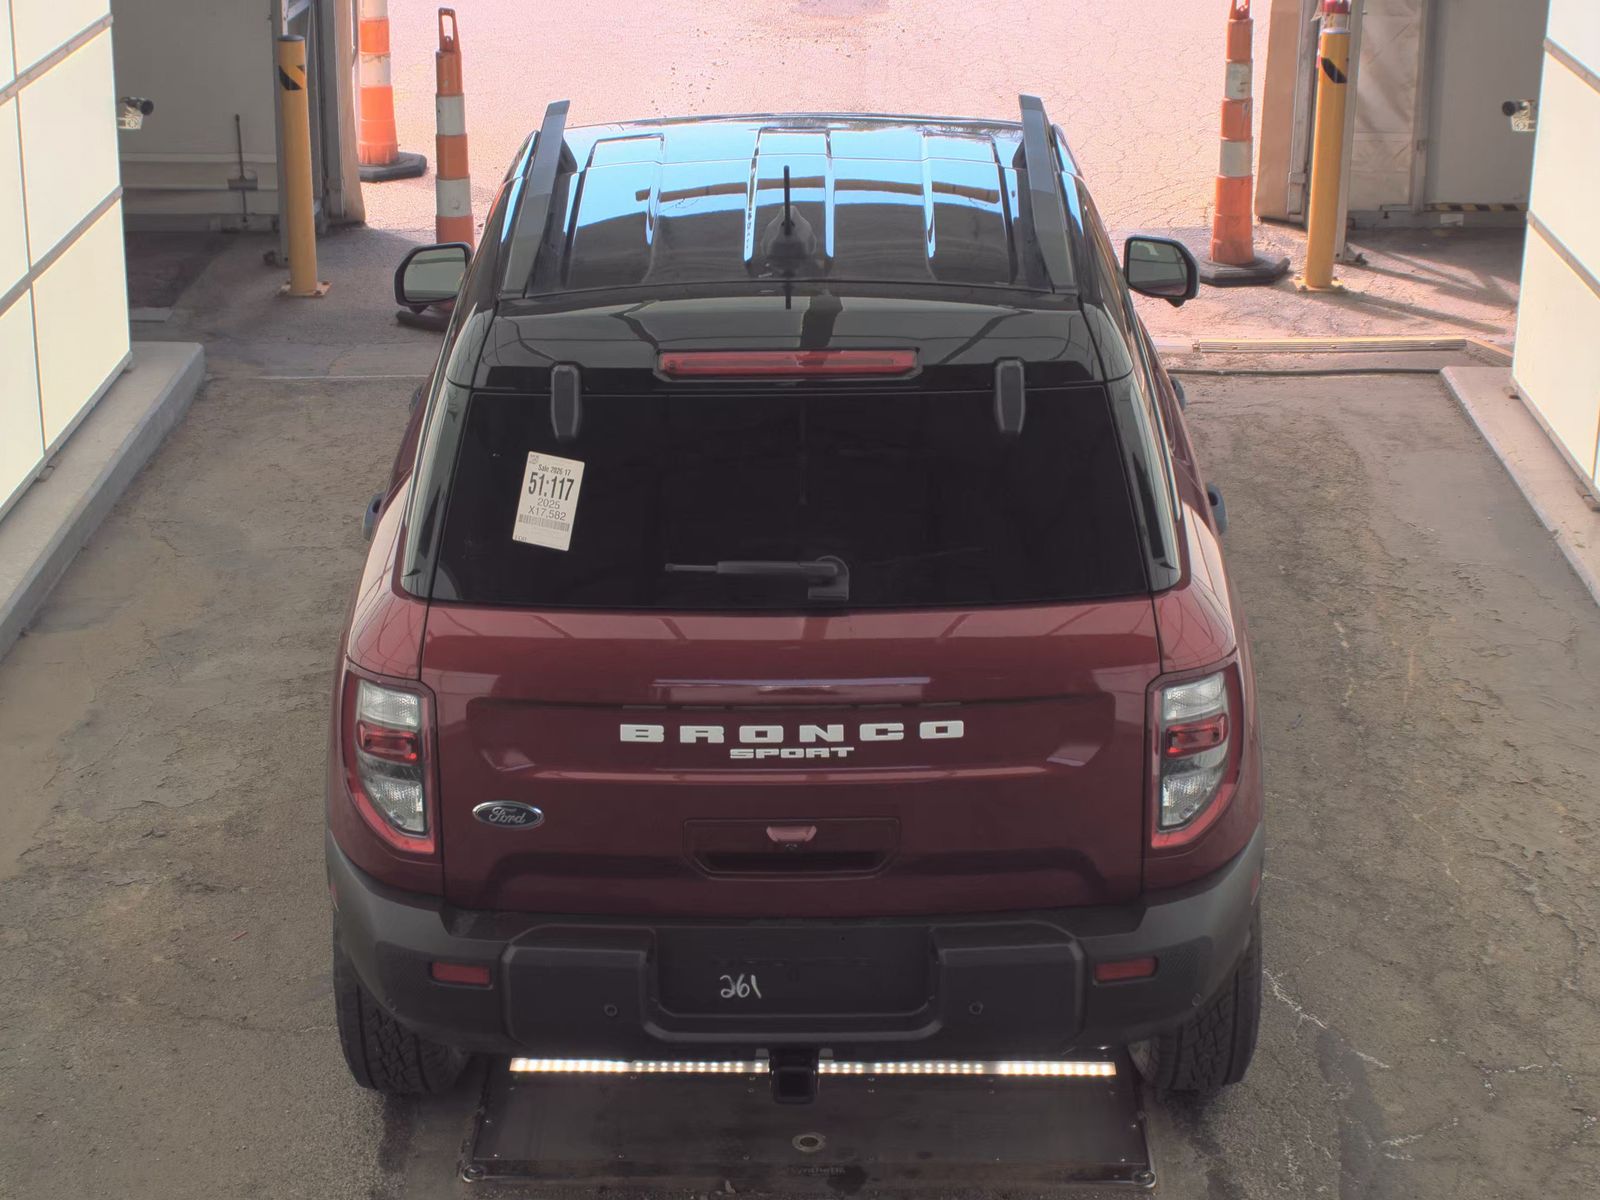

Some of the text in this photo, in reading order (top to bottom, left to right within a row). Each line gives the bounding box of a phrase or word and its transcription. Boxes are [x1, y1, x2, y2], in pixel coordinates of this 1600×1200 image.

[538, 464, 549, 473] Sale
[528, 472, 575, 501] 51:117
[537, 498, 560, 510] 2025
[619, 720, 965, 743] BRONCO
[729, 746, 855, 759] SPORT
[487, 806, 527, 825] Ford
[719, 973, 762, 999] 261
